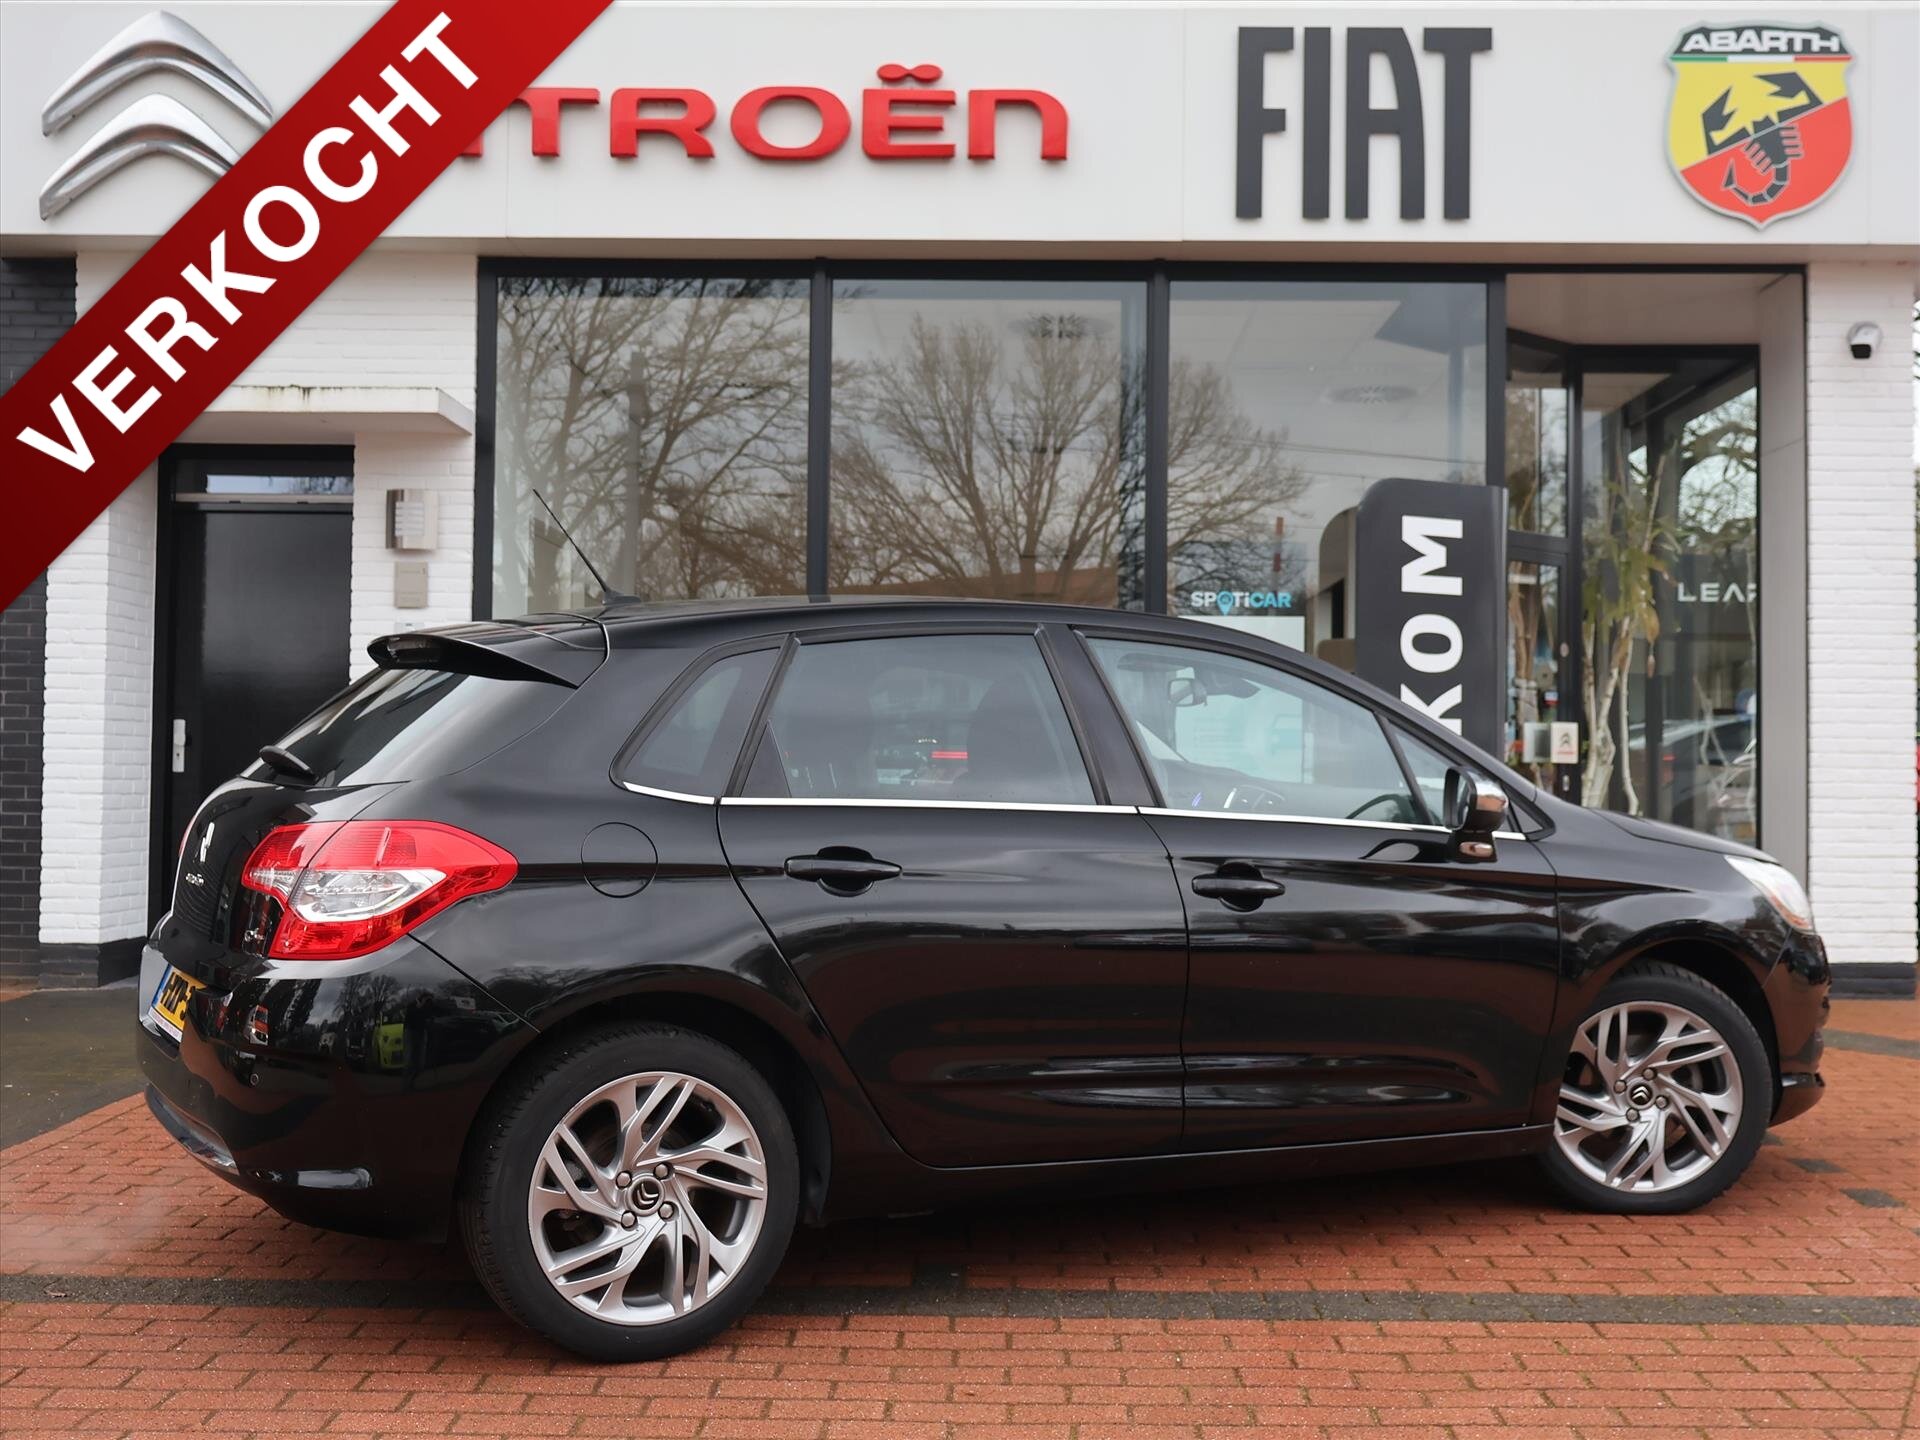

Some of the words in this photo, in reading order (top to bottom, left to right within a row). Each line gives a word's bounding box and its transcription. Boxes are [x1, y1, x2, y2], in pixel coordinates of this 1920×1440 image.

[1682, 29, 1841, 53] ABARTH
[458, 63, 1069, 161] TROËN
[1236, 26, 1493, 220] FIAT
